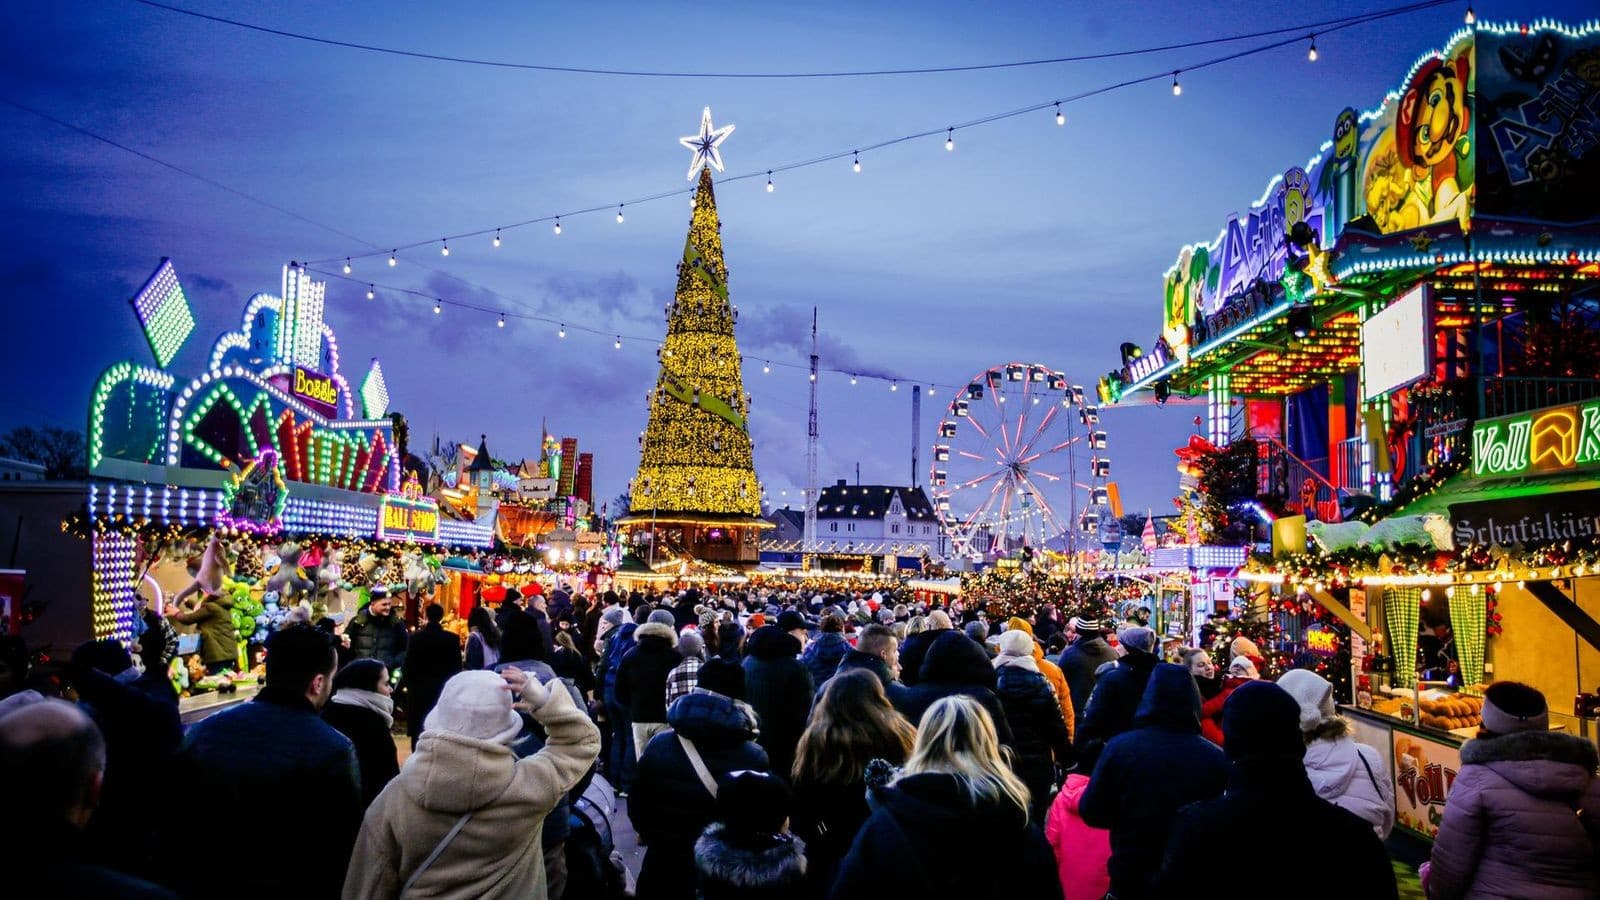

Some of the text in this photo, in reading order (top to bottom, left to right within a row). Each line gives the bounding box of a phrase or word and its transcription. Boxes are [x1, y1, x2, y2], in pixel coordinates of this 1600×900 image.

[295, 368, 337, 405] Boggle
[1473, 418, 1532, 475] Voll
[384, 505, 436, 533] BALL SHOP
[1398, 762, 1447, 810] Voll
